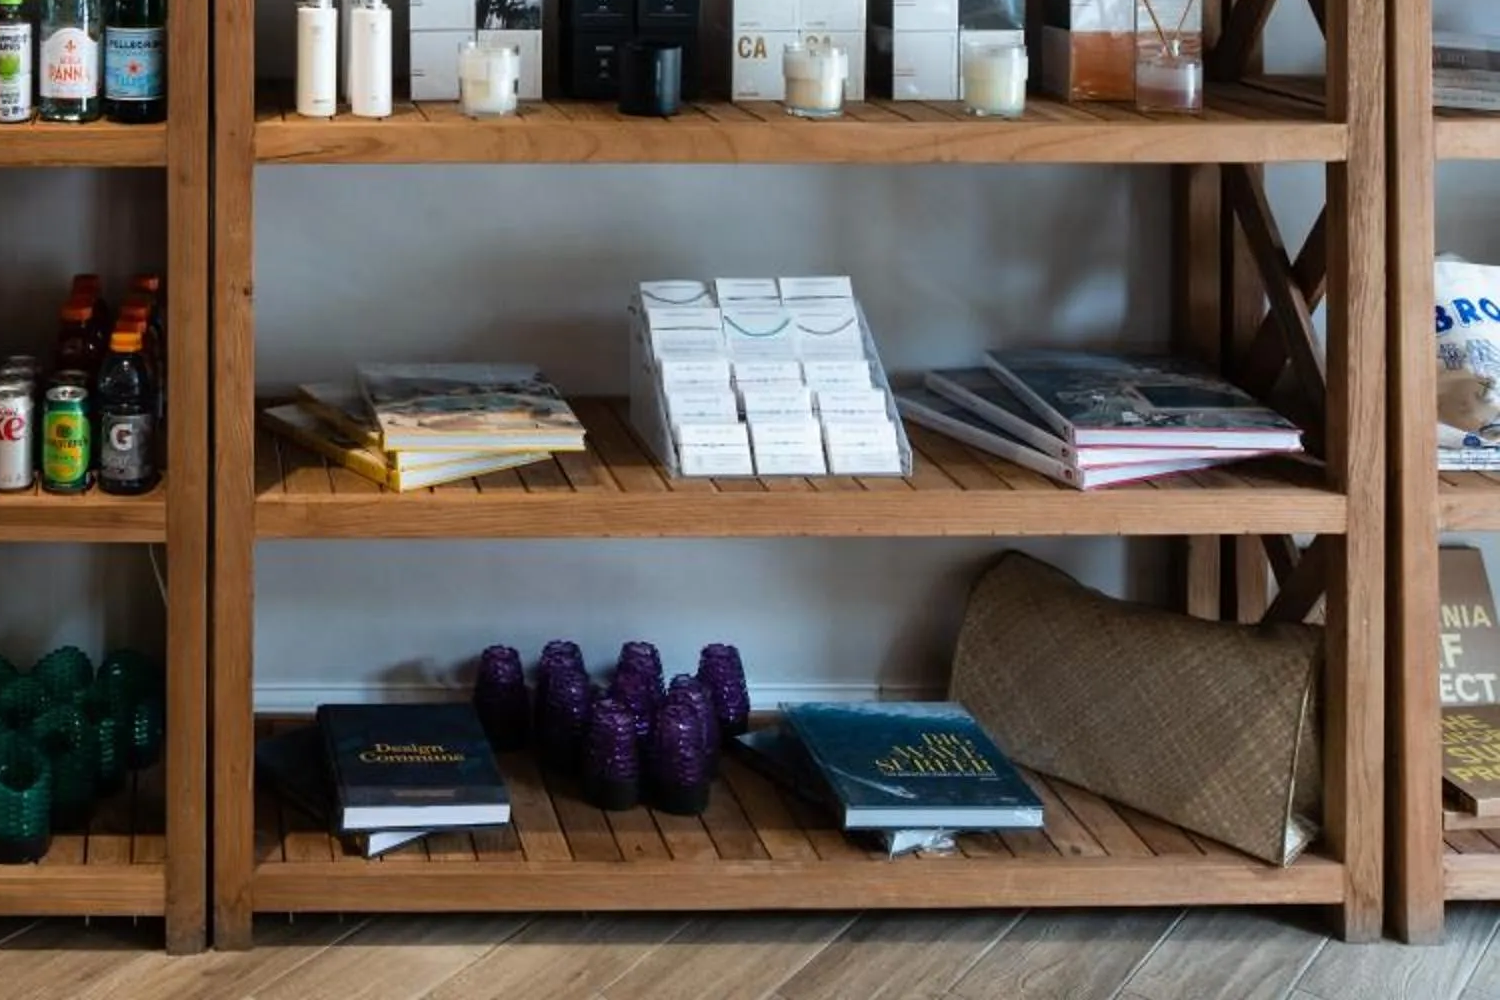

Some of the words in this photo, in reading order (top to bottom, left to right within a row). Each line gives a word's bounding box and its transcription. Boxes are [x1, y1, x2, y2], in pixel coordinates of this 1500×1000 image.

[737, 36, 768, 59] CA
[1440, 604, 1492, 628] NIA
[1440, 632, 1464, 668] F
[359, 752, 466, 763] Commune
[375, 743, 444, 755] Design
